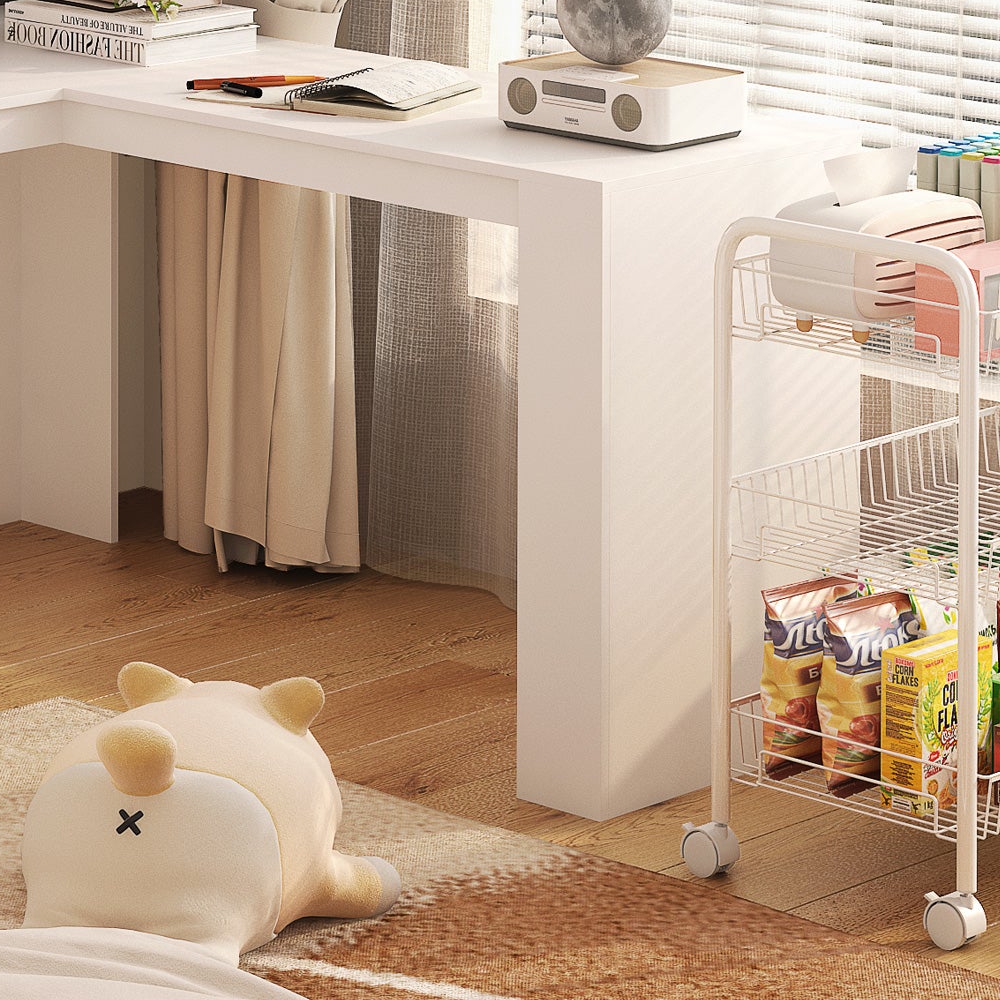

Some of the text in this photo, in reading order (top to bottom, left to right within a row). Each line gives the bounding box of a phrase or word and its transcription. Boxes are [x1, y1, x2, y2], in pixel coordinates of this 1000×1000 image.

[61, 14, 144, 36] THE ALLURE OF BEAUTY
[894, 664, 914, 677] CORN
[892, 673, 919, 687] FLAKES
[938, 704, 958, 733] FLA
